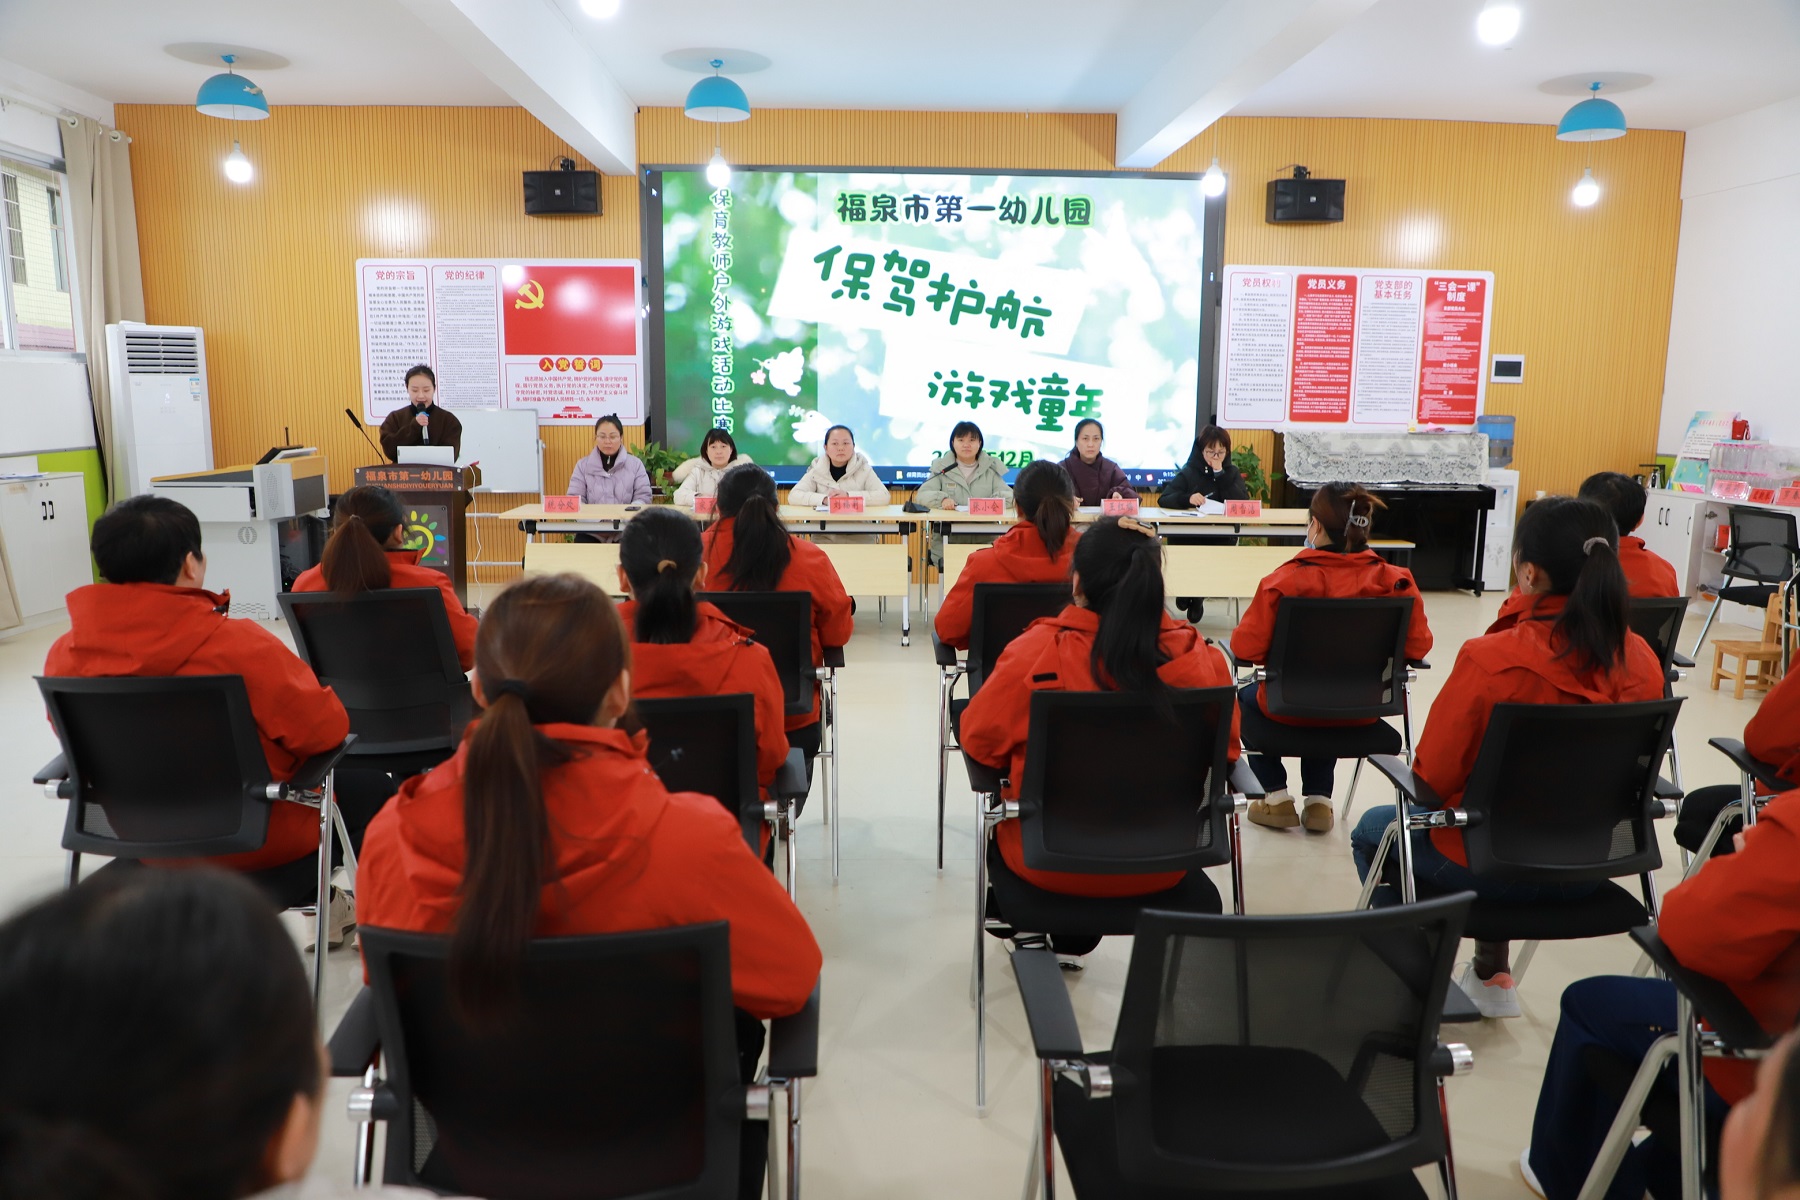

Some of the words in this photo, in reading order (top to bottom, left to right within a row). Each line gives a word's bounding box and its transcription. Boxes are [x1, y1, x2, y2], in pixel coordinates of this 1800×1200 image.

[837, 193, 1092, 226] 福泉市第一幼儿园
[375, 270, 415, 281] 党的宗旨
[444, 270, 485, 281] 党的纪律
[1307, 278, 1347, 290] 党员义务
[1374, 280, 1413, 290] 党支部的
[813, 245, 1053, 339] 保驾护航
[1374, 290, 1412, 300] 基本任务
[1446, 292, 1466, 302] 制度
[541, 358, 601, 371] 入党誓词
[927, 370, 1104, 432] 游戏童年
[365, 471, 454, 481] 福泉市第一幼儿园
